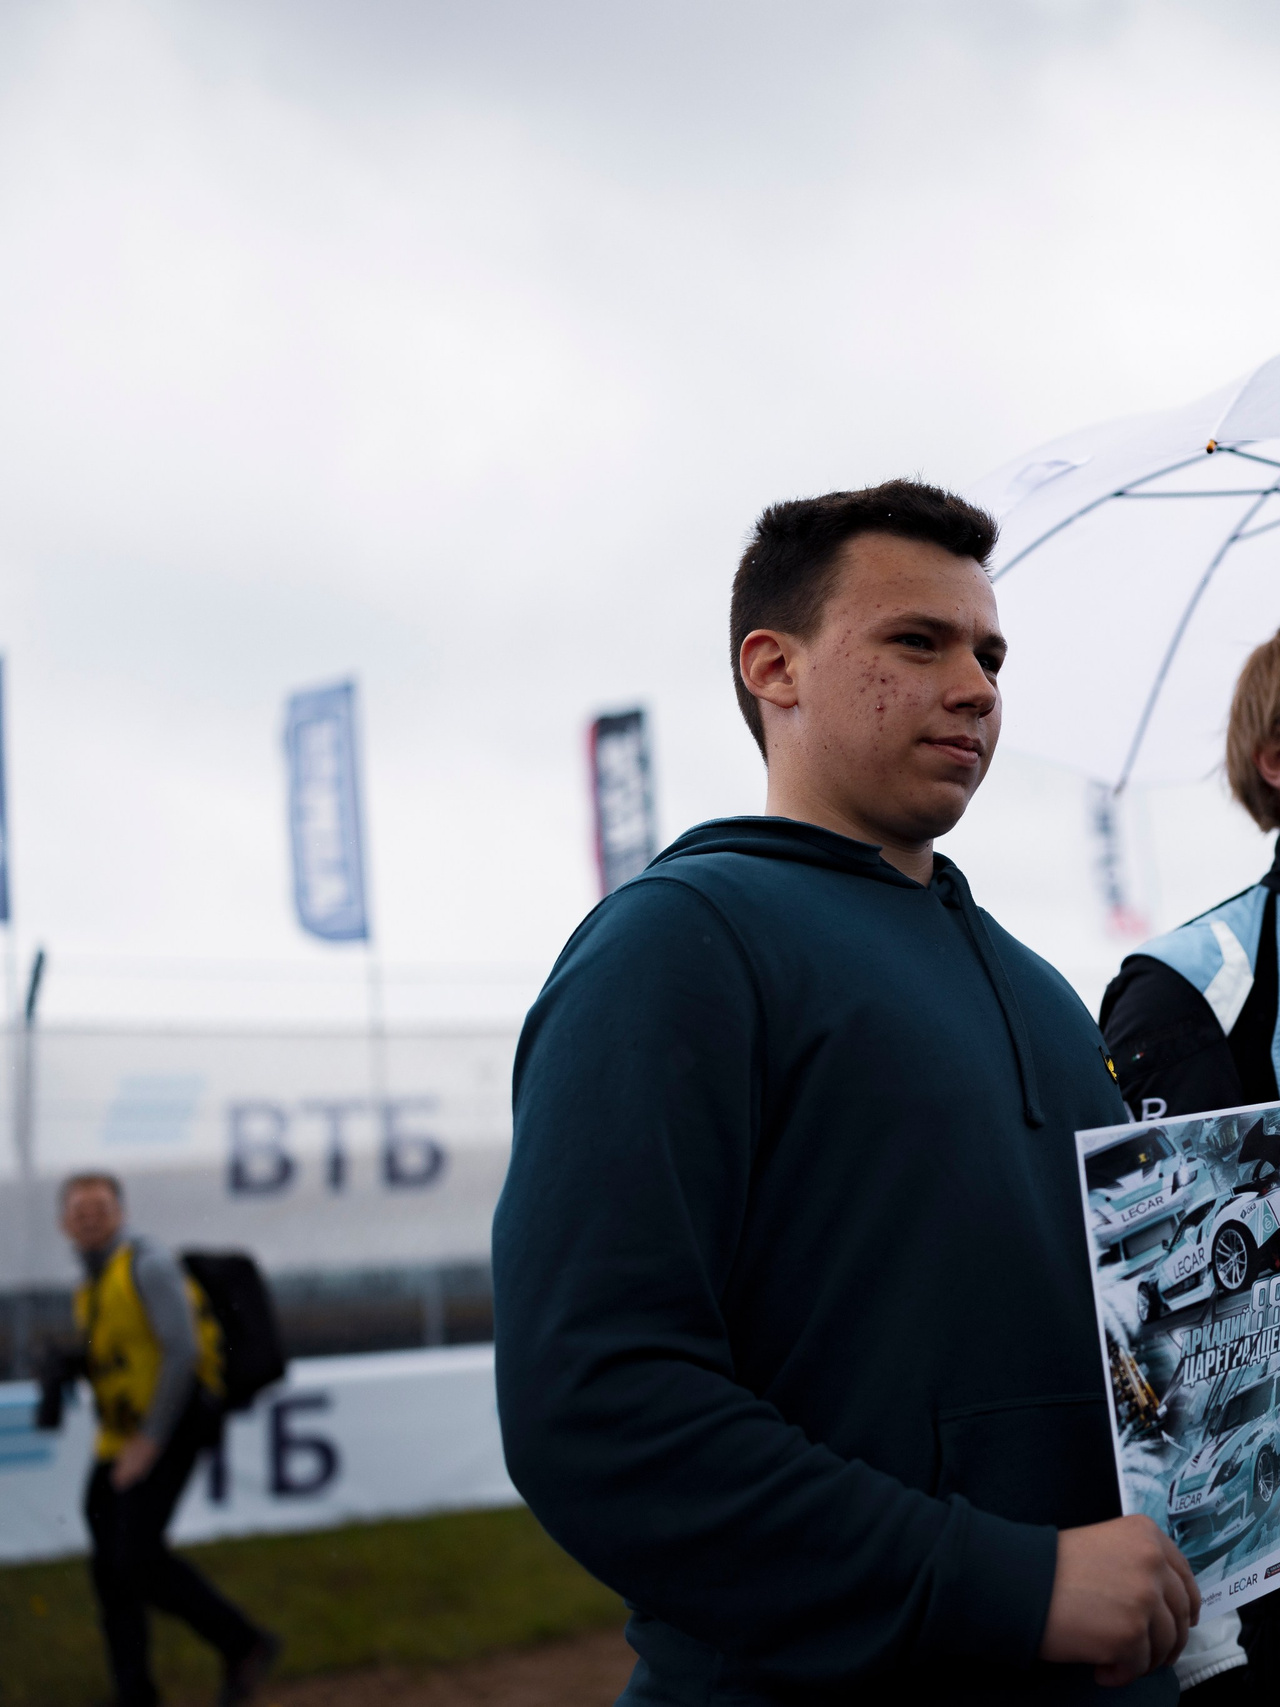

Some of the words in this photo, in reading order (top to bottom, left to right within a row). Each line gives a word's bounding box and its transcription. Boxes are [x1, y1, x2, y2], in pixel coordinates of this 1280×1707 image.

[226, 1097, 447, 1199] ВТБ
[1120, 1195, 1165, 1223] LECAR
[1172, 1247, 1206, 1280] LECAR
[1181, 1307, 1251, 1358] АРКАДИЙ
[1174, 1492, 1203, 1512] LECAR
[1228, 1573, 1258, 1596] LECAR
